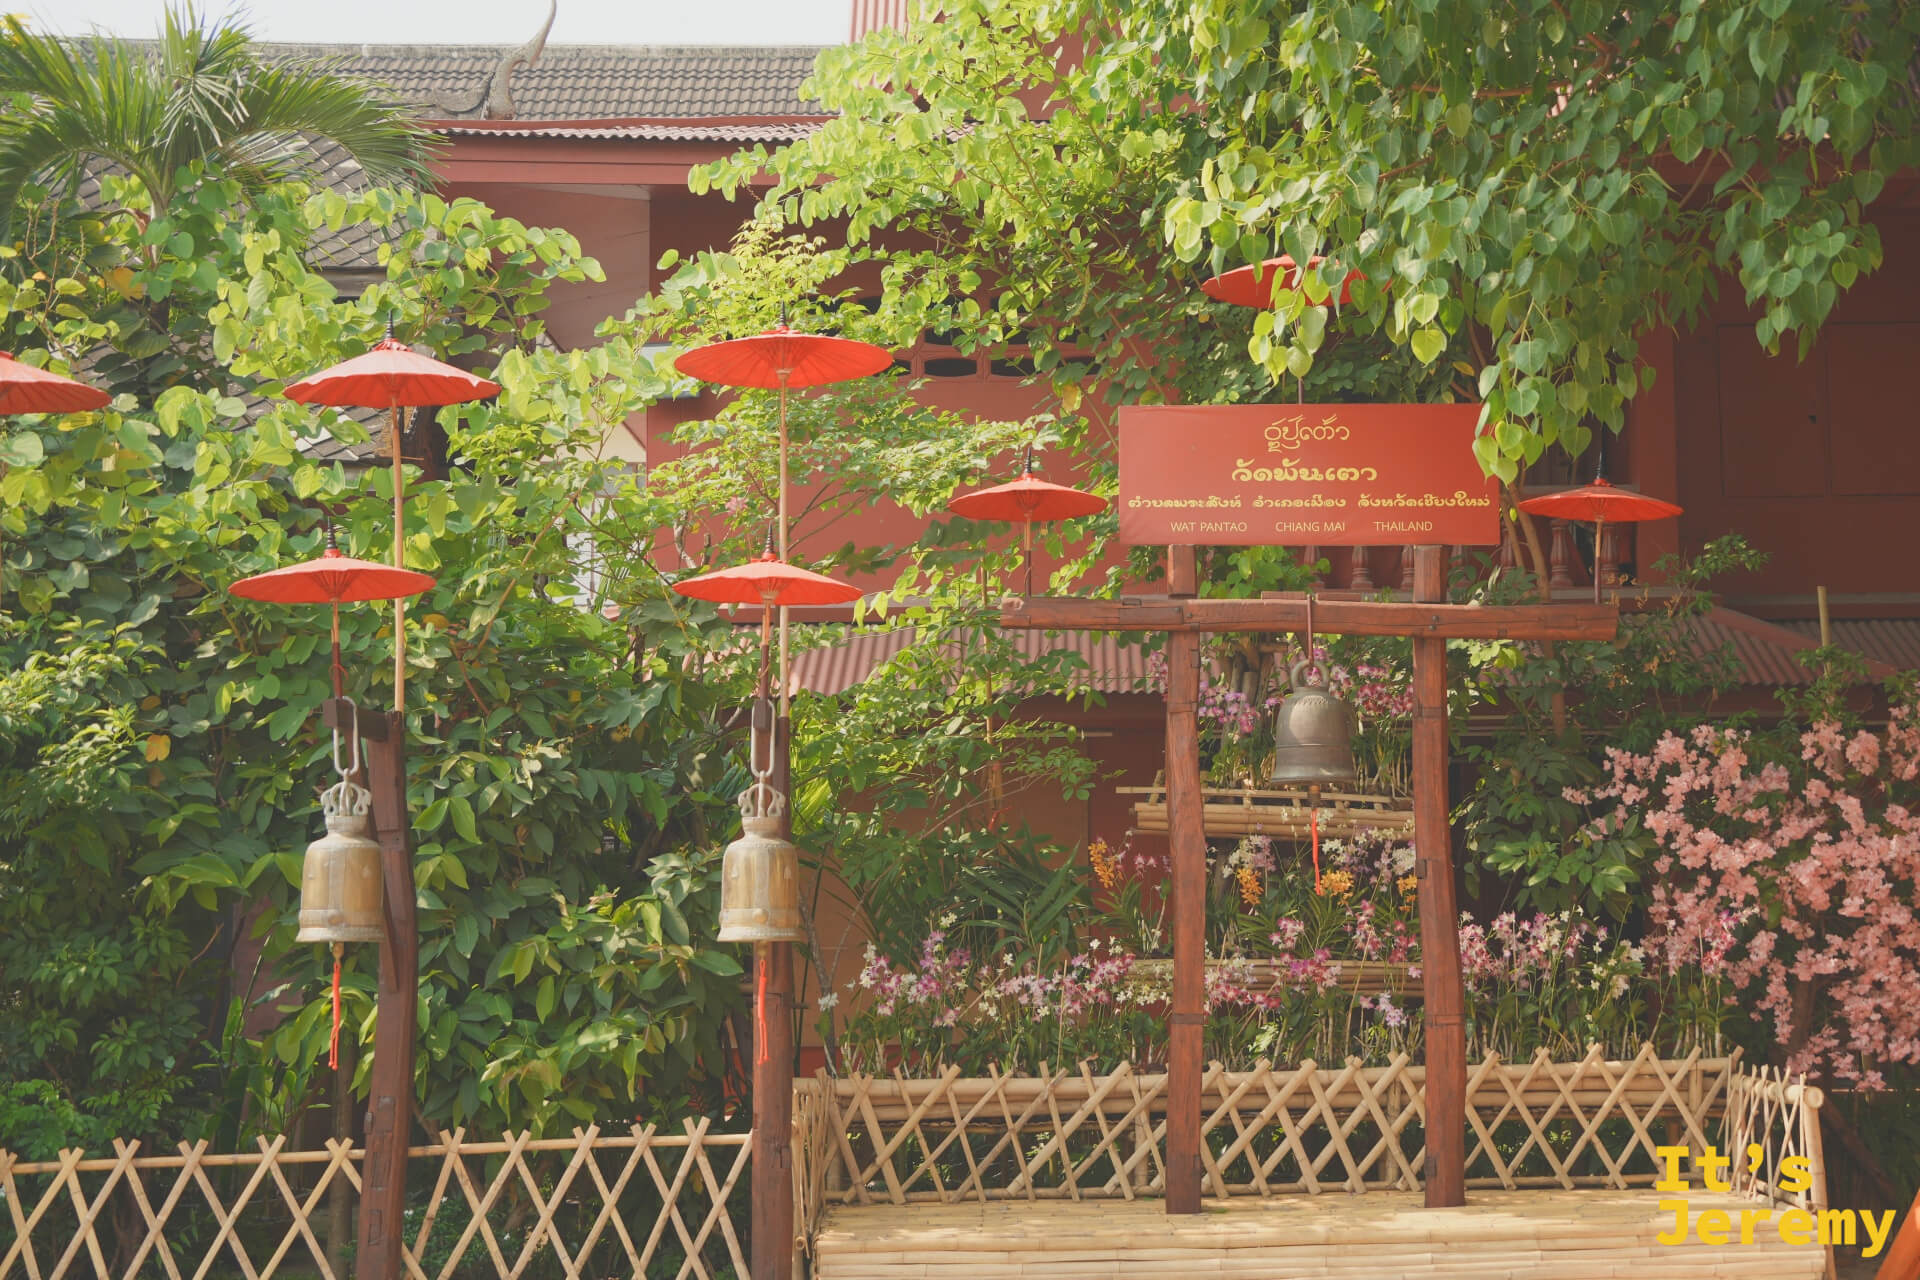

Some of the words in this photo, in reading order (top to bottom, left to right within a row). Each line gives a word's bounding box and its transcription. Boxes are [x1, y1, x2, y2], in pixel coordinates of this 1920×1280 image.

[1231, 458, 1378, 482] วัดพันเตา
[1127, 495, 1242, 508] ตำบลพระสิงห์
[1252, 494, 1347, 508] อำเภอเมือง
[1357, 490, 1491, 508] จังหวัดเชียงใหม่
[1170, 521, 1197, 532] WAT
[1199, 521, 1248, 532] PANTAO
[1275, 521, 1320, 532] CHIANG
[1323, 521, 1345, 532] MAI
[1373, 521, 1433, 532] THAILAND
